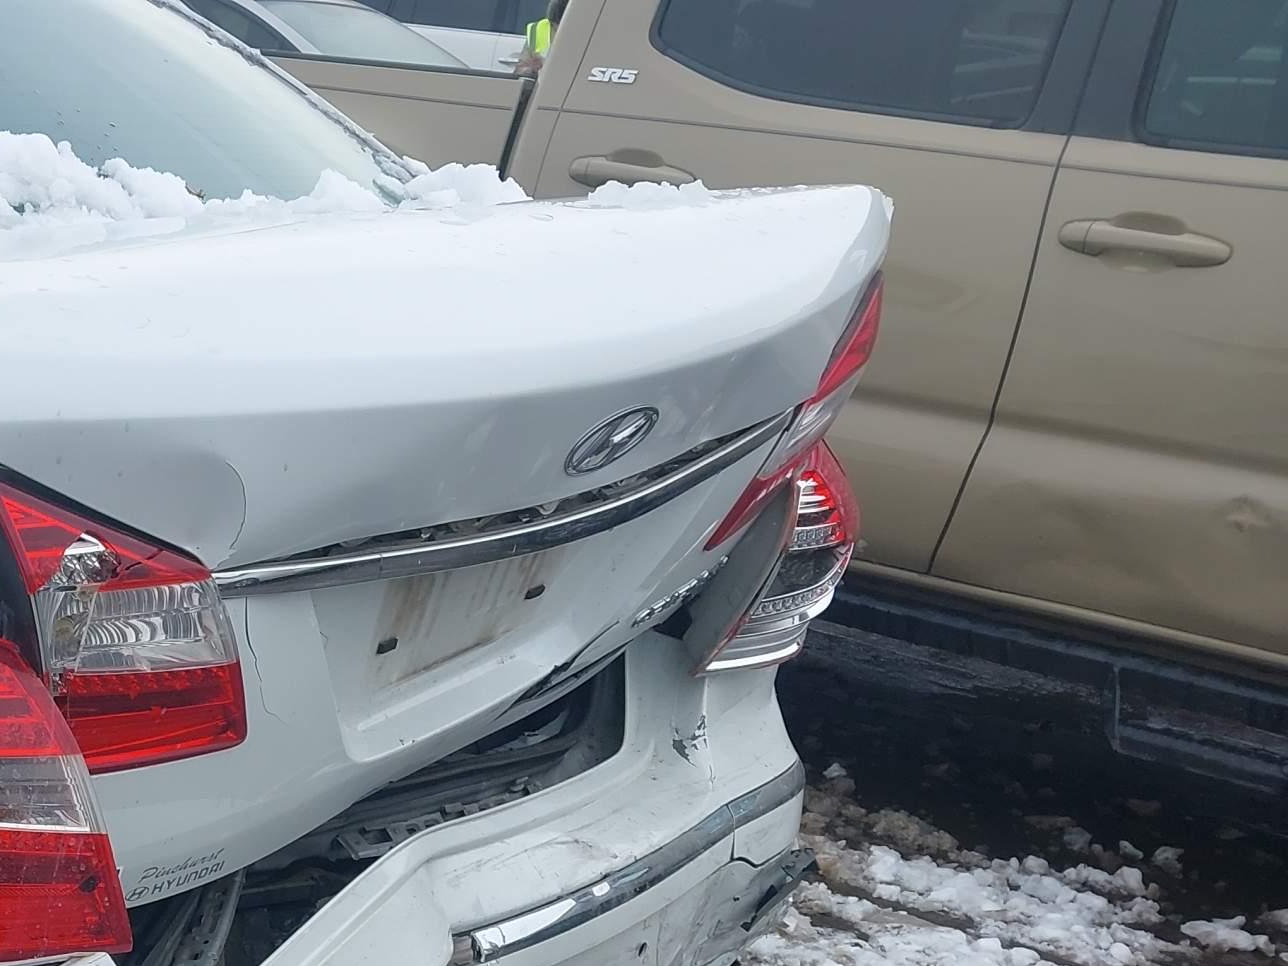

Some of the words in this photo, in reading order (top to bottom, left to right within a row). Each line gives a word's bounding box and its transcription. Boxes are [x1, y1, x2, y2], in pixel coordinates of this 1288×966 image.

[587, 66, 640, 85] SR5
[138, 848, 225, 883] Pinehurst
[151, 860, 225, 895] HYUNDAI
